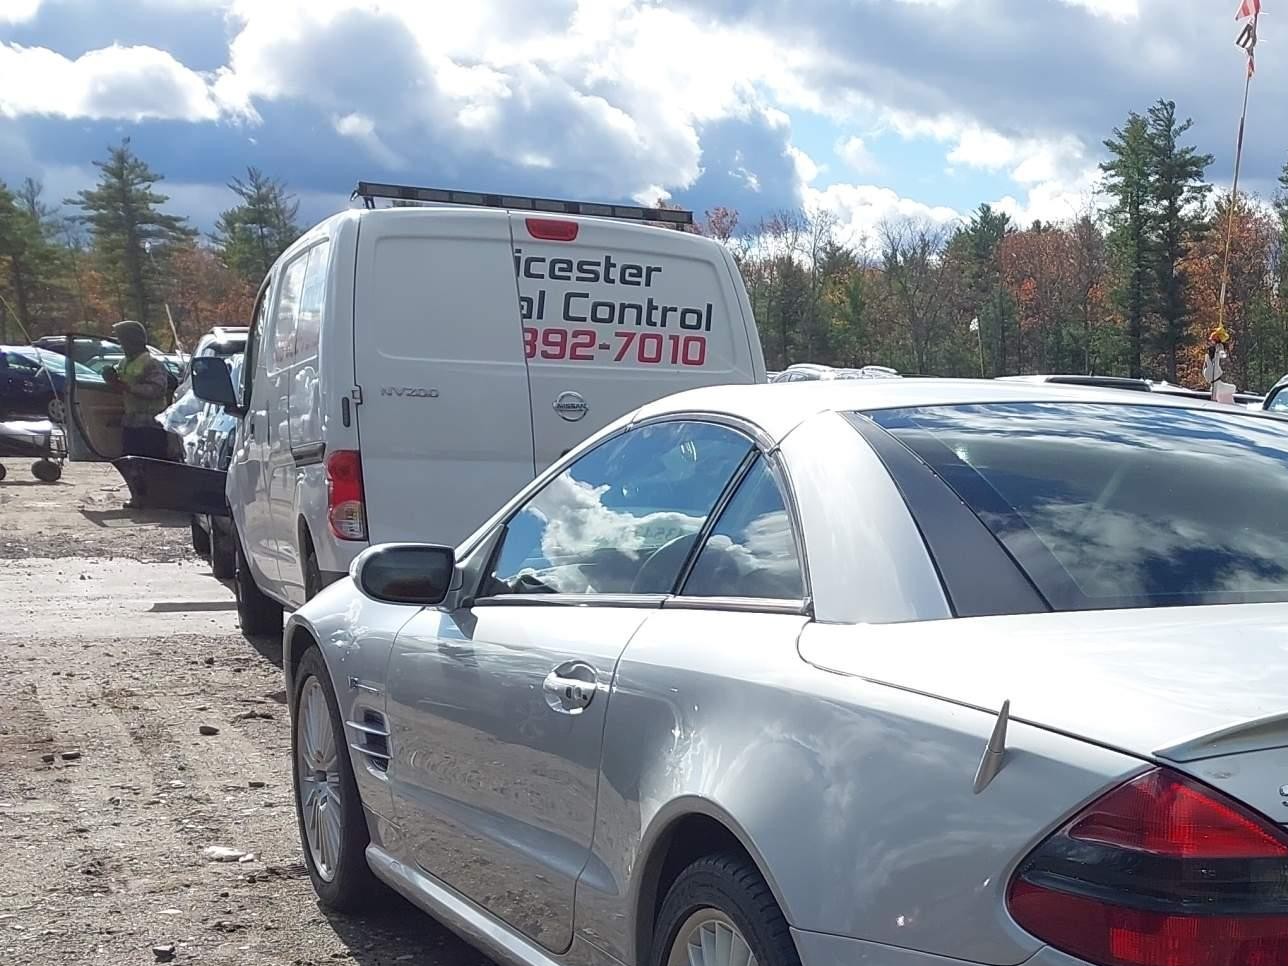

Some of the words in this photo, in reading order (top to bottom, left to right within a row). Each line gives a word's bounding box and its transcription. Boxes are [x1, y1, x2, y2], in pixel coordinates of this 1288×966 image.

[562, 291, 713, 332] Control
[380, 386, 440, 398] NV200
[556, 401, 587, 410] NISSAN
